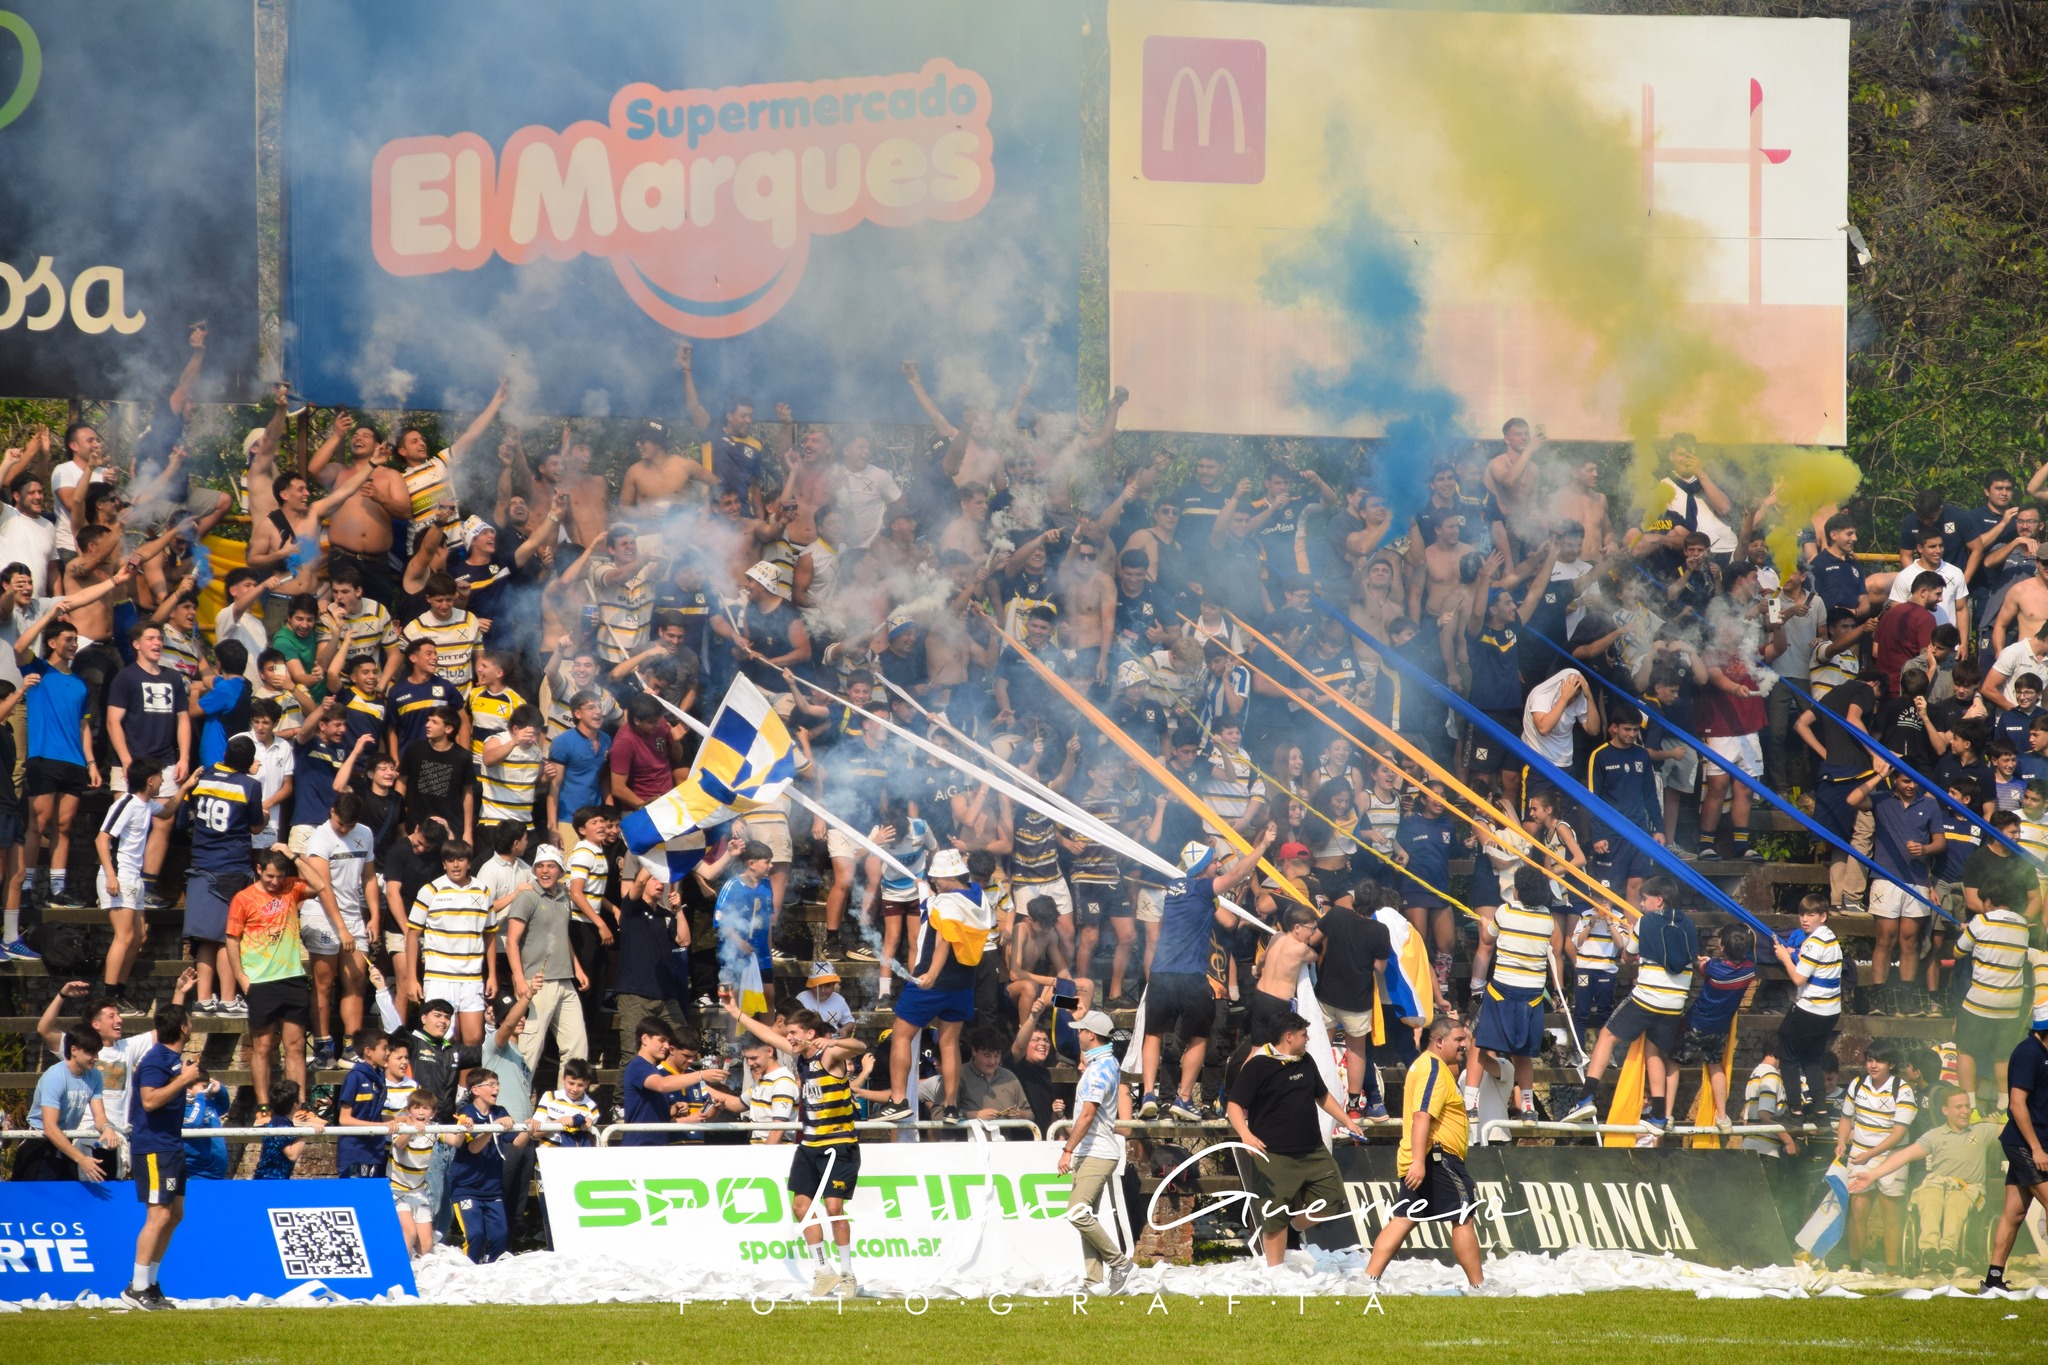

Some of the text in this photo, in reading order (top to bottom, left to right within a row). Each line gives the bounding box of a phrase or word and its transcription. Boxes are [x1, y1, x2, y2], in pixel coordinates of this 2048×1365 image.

[626, 73, 978, 149] Supermercado
[390, 131, 982, 256] El Marques
[197, 796, 230, 832] 48
[934, 785, 958, 801] AIG
[573, 1173, 1072, 1227] SPOTING
[1344, 1181, 1699, 1250] FEET BRANCA
[0, 1221, 85, 1236] TICOS
[0, 1238, 95, 1273] RTE
